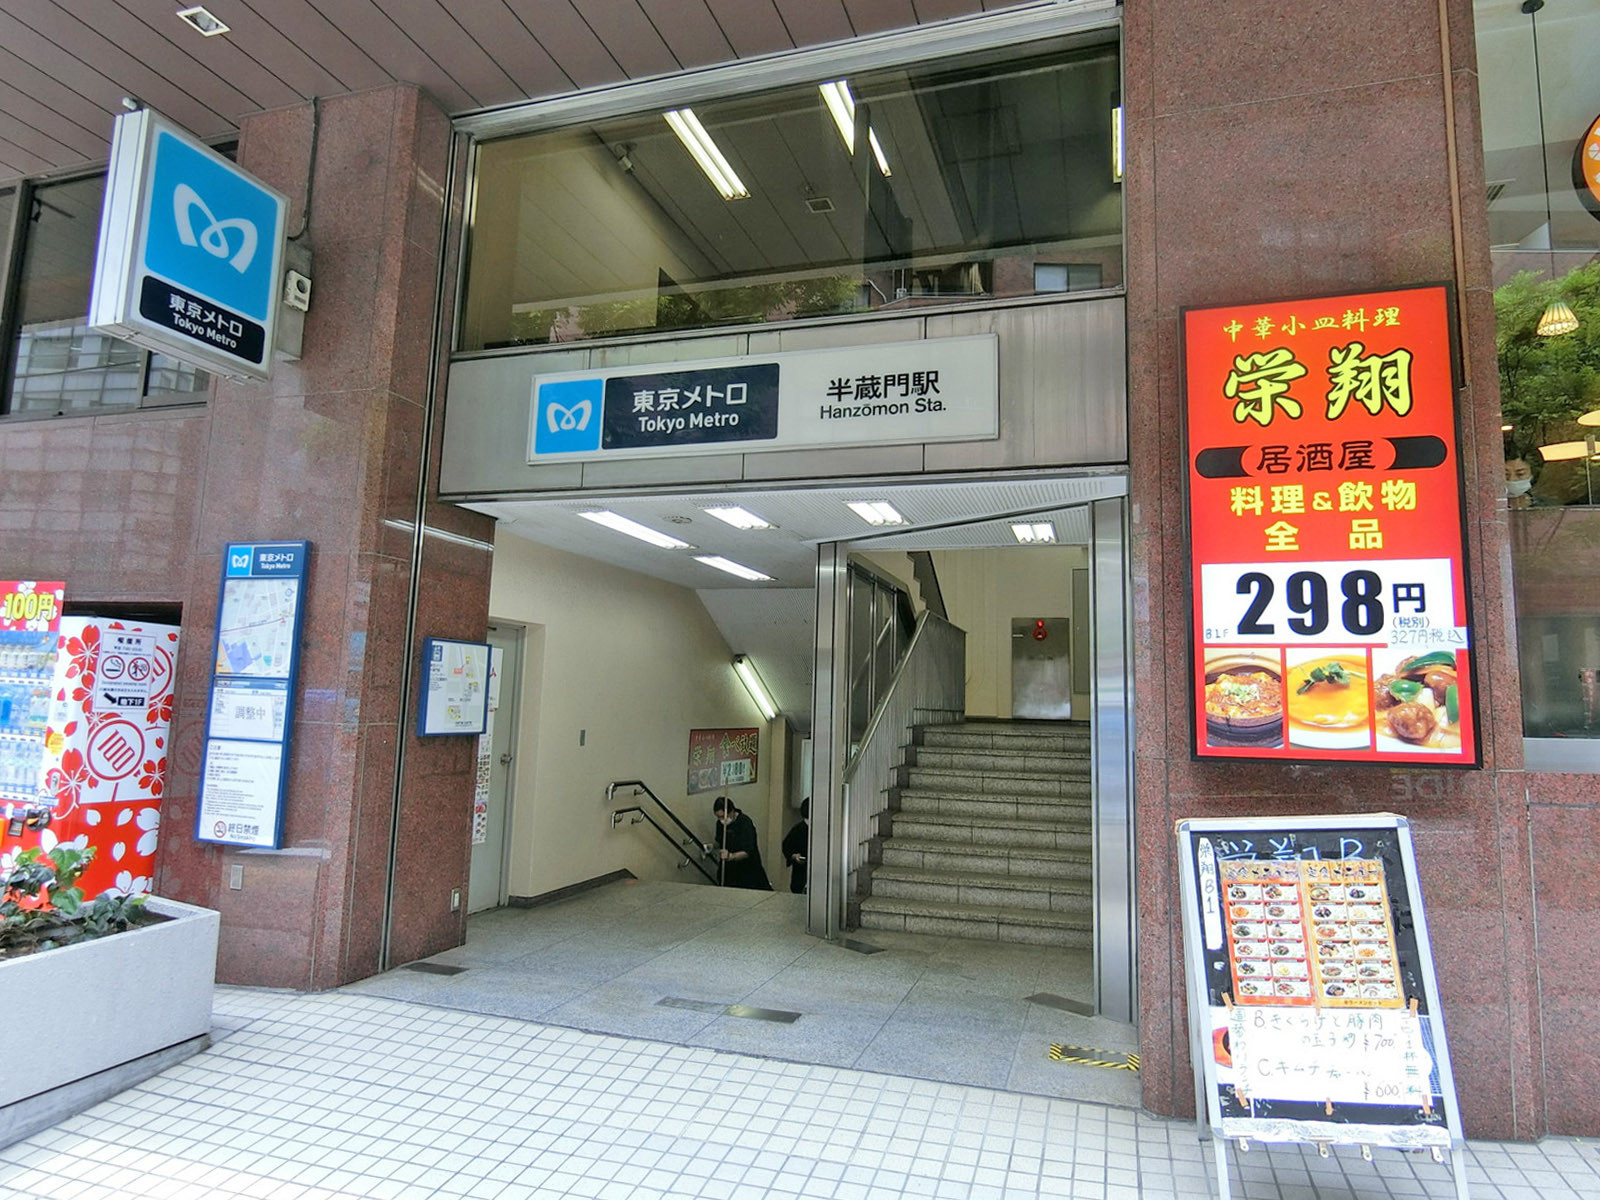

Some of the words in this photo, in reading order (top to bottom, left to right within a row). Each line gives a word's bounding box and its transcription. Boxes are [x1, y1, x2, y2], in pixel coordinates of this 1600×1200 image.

[169, 293, 243, 337] 東京メトロ
[172, 312, 205, 337] Tokyo
[206, 327, 237, 349] Metro
[1223, 306, 1401, 343] 中華小皿料理
[632, 382, 748, 413] 東京メトロ
[826, 370, 940, 403] 半蔵門駅
[1223, 341, 1413, 427] 栄翔
[638, 414, 685, 435] Tokyo
[689, 410, 740, 429] Metro
[819, 401, 910, 421] Hanzōmon
[914, 397, 947, 414] Sta.
[1256, 440, 1377, 474] 居酒屋
[259, 553, 294, 563] 東京メトロ
[261, 562, 276, 570] Tokyo
[276, 562, 291, 570] Metro
[4, 592, 55, 622] 100円
